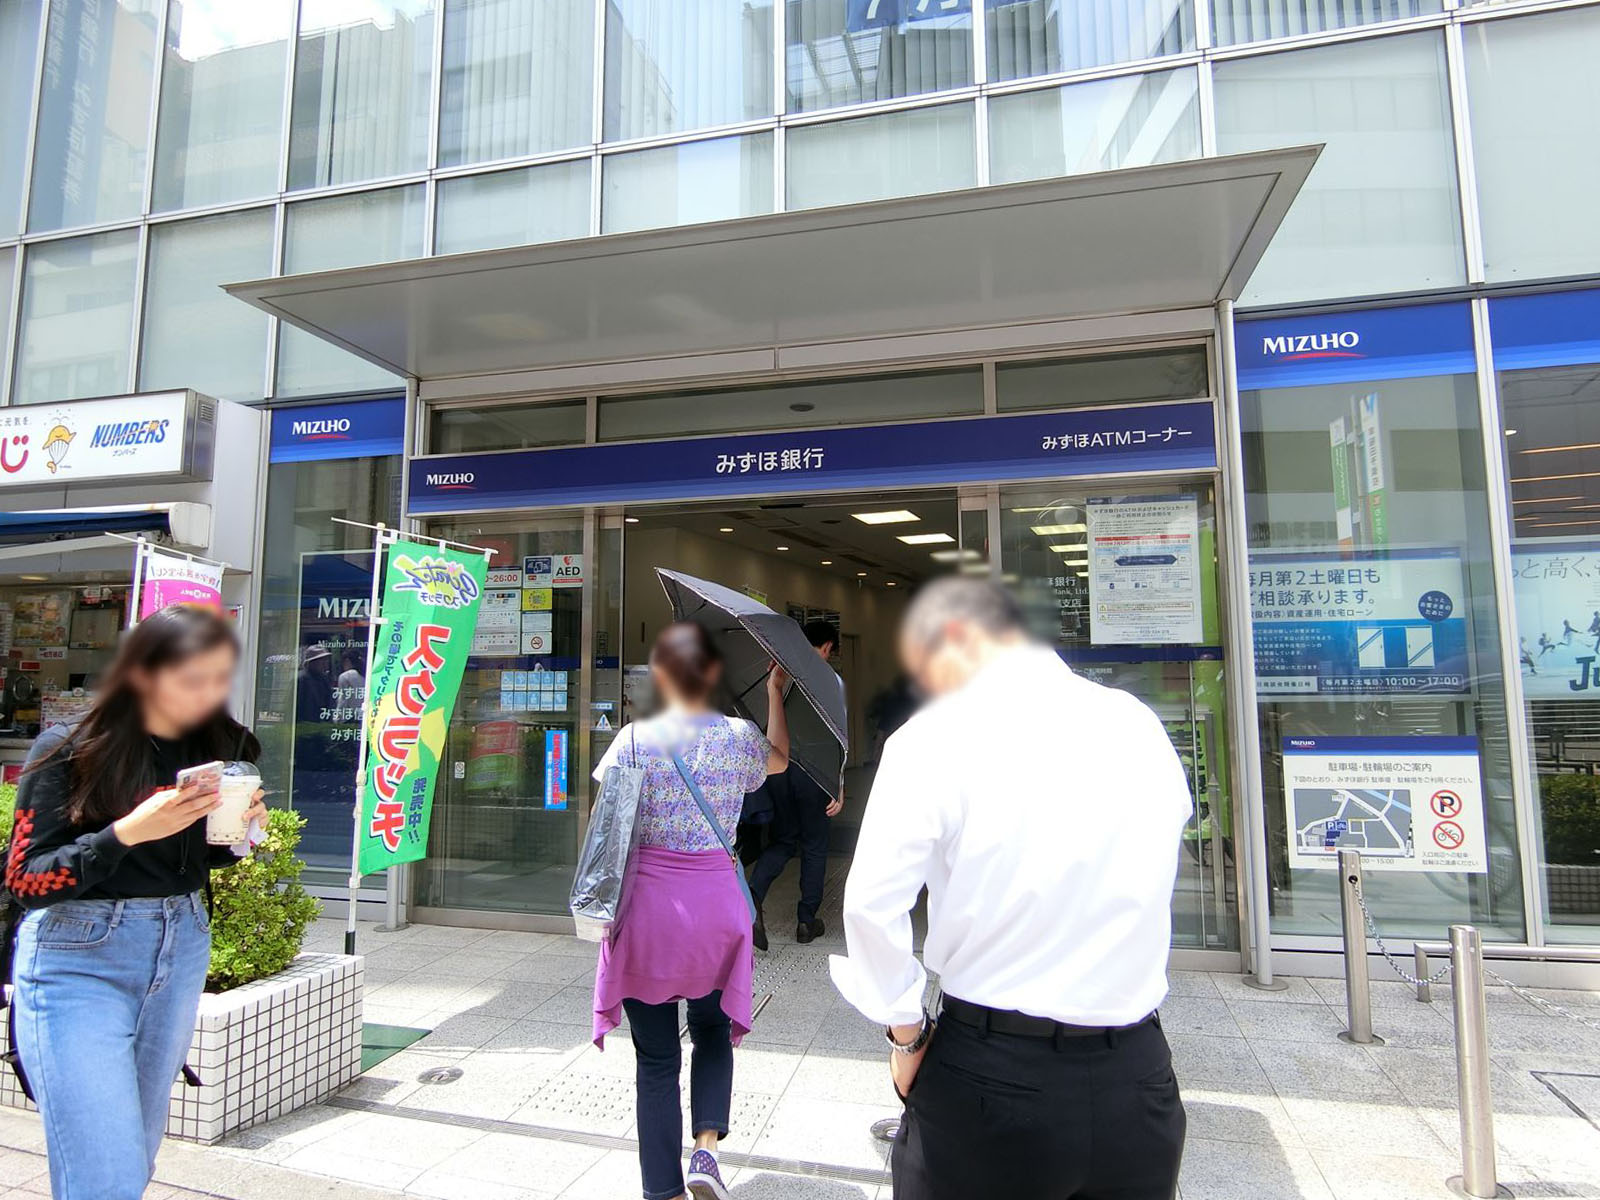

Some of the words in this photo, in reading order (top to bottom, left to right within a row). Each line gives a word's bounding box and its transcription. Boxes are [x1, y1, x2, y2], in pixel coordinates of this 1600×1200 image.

[1263, 331, 1360, 355] MIZUHO
[89, 418, 170, 449] NUMBERS
[291, 418, 350, 435] MIZUHO
[1042, 426, 1193, 451] みずほATMコーナー
[715, 447, 825, 474] みずほ銀行
[426, 472, 475, 486] MIZUHO
[556, 566, 581, 577] AED
[317, 640, 347, 649] Mizuho
[1327, 761, 1433, 773] 駐車場・駐輪場のご案内
